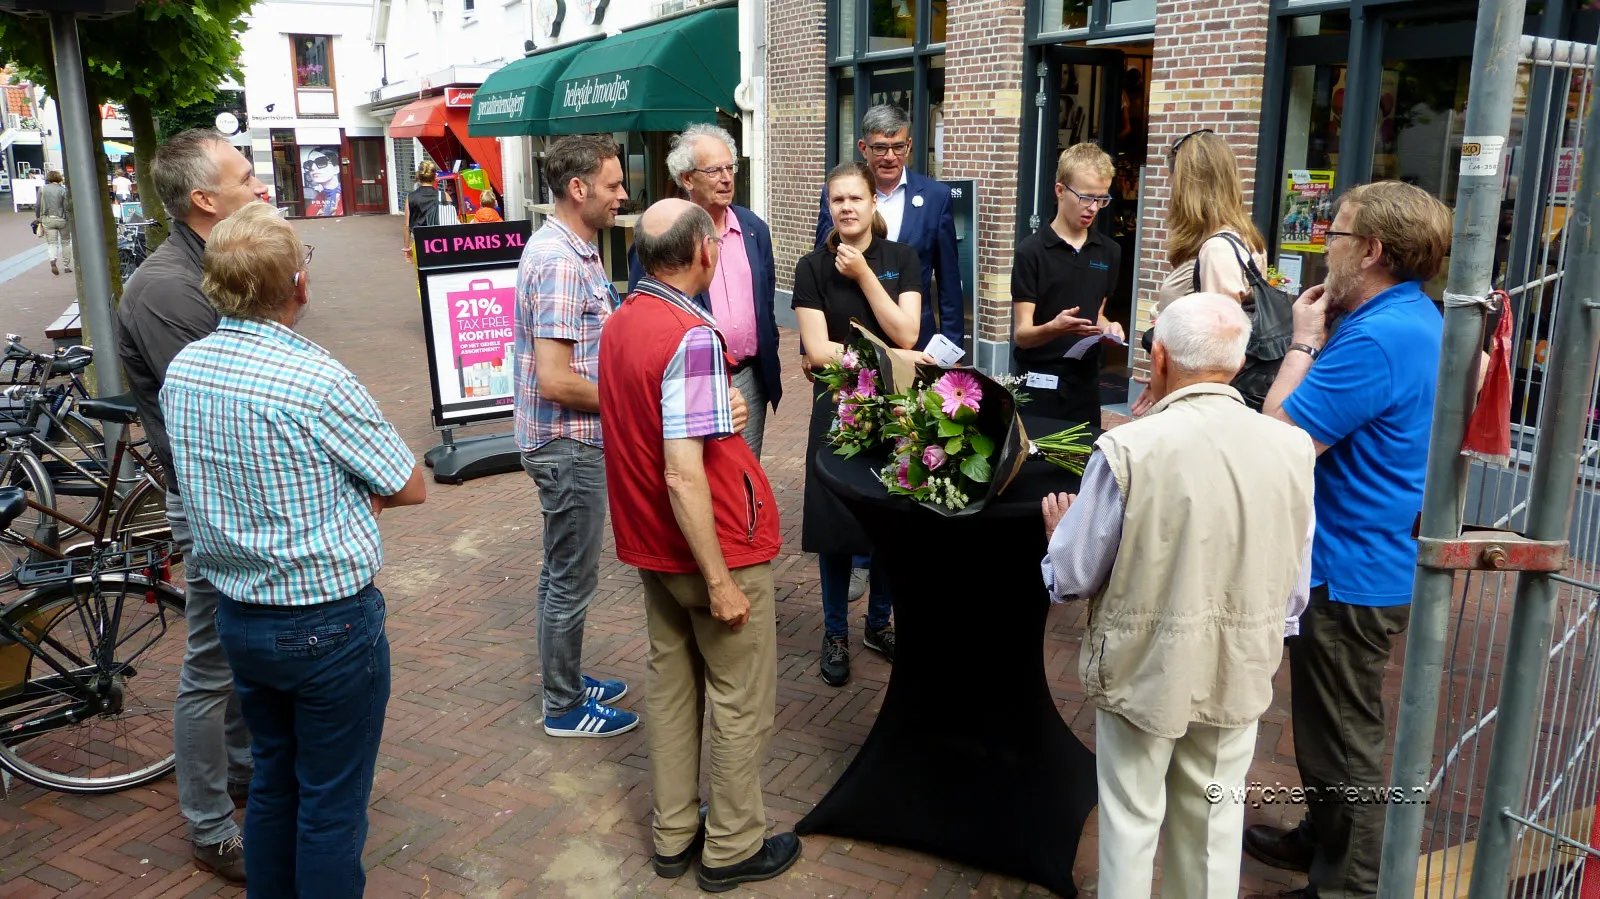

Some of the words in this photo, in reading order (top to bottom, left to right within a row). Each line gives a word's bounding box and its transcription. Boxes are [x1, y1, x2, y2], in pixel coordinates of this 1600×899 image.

[563, 79, 592, 112] belegde
[592, 74, 630, 109] broodjes
[477, 91, 526, 121] specialiteitenslagerij
[950, 187, 963, 196] SS
[423, 238, 448, 254] ICI
[453, 234, 501, 252] PARIS
[505, 233, 525, 247] XL
[455, 297, 503, 318] 21%
[457, 318, 480, 331] TAX
[482, 315, 510, 328] FREE
[458, 327, 513, 342] KORTING
[480, 340, 501, 348] GEHELE
